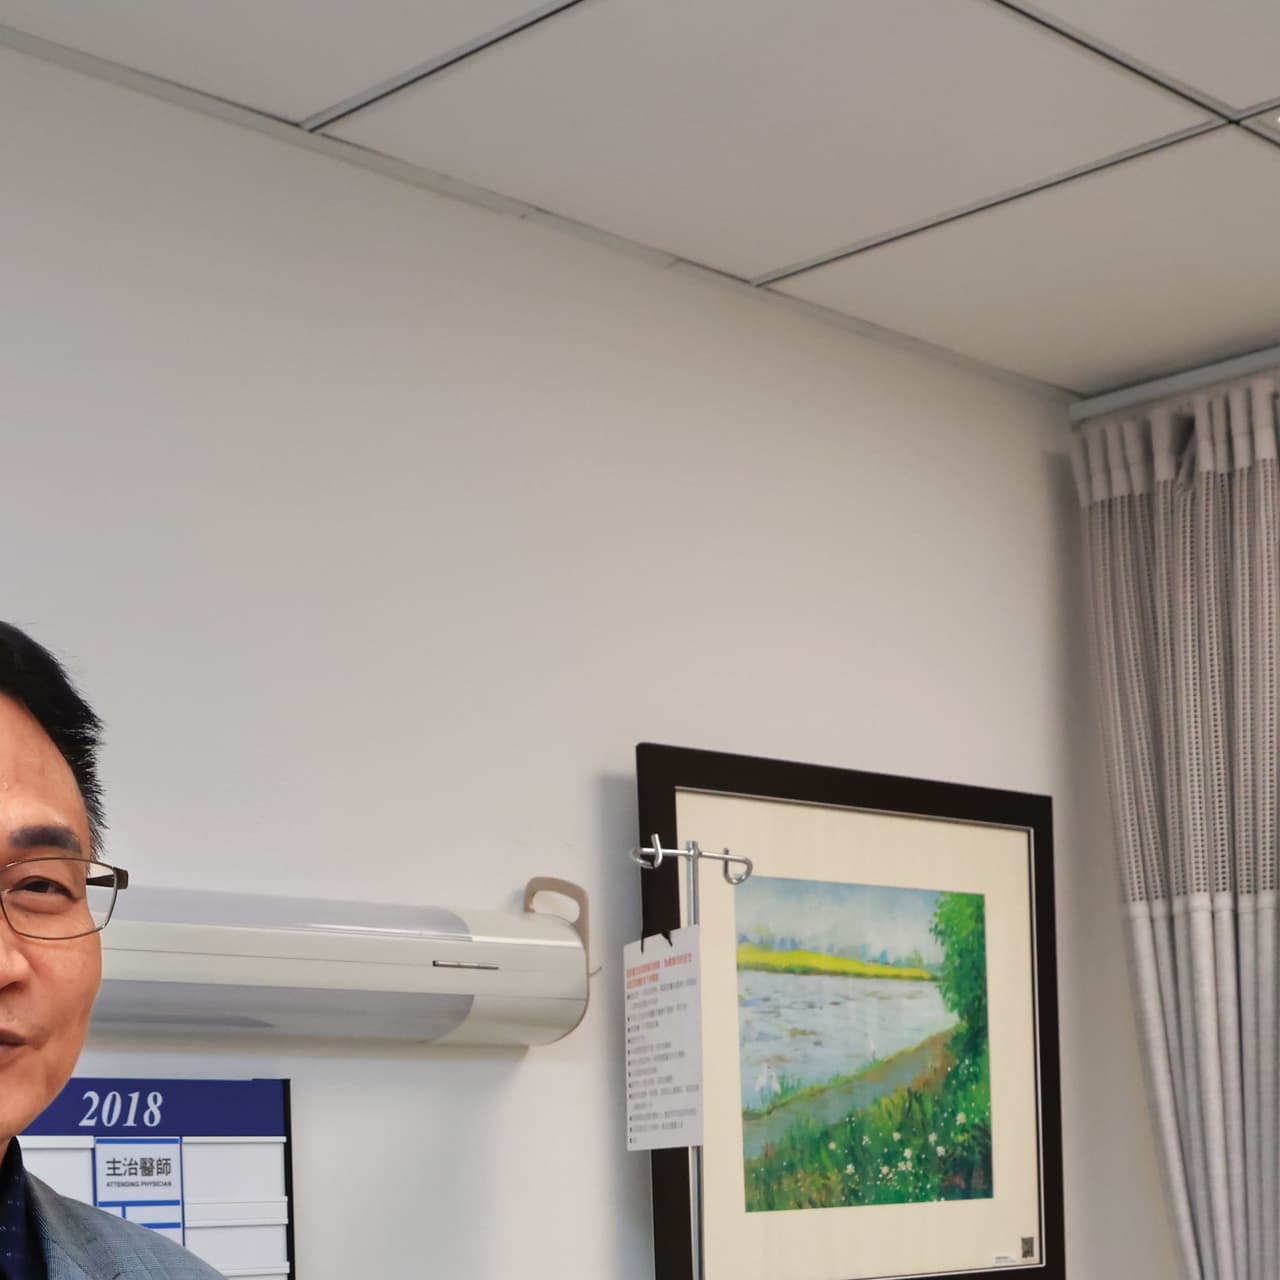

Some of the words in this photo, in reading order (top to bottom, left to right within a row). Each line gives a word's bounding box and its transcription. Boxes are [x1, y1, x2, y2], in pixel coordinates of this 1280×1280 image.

[78, 1090, 163, 1127] 2018
[105, 1157, 172, 1177] 主治醫師
